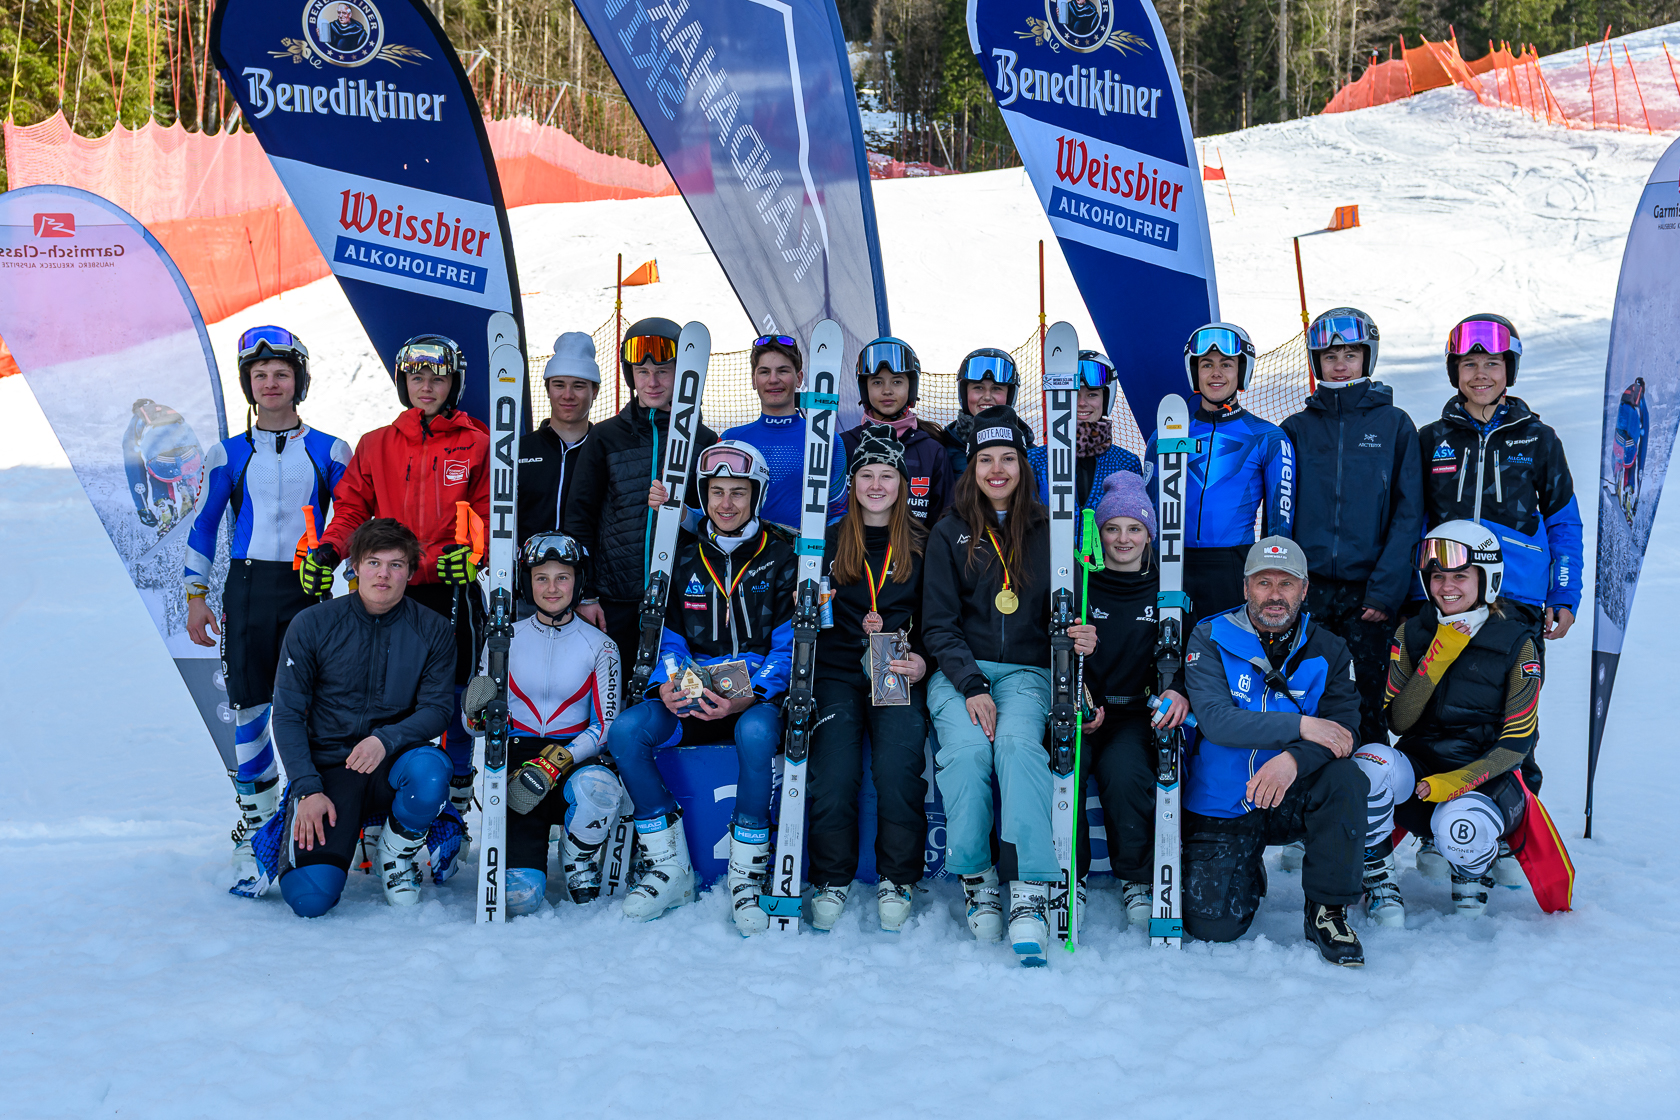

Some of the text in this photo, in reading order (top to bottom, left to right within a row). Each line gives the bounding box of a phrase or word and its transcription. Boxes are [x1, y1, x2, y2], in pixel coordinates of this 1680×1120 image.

[242, 67, 447, 122] Benediktiner
[992, 48, 1162, 118] Benediktiner
[1056, 135, 1184, 213] Weissbier
[339, 189, 490, 257] Weissbier
[1058, 196, 1170, 243] ALKOHOLFREI
[344, 244, 476, 286] ALKOHOLFREI
[662, 370, 700, 508] HEAD
[1433, 449, 1456, 458] ASV
[493, 396, 516, 539] HEAD
[1474, 551, 1498, 561] uvex
[1477, 537, 1494, 551] uvex
[685, 584, 705, 594] ASV
[604, 669, 619, 721] Schöffel
[1447, 771, 1489, 801] GERMANY
[737, 830, 766, 839] HEAD
[1458, 823, 1468, 839] B
[485, 847, 498, 922] HEAD
[778, 854, 794, 931] HAD
